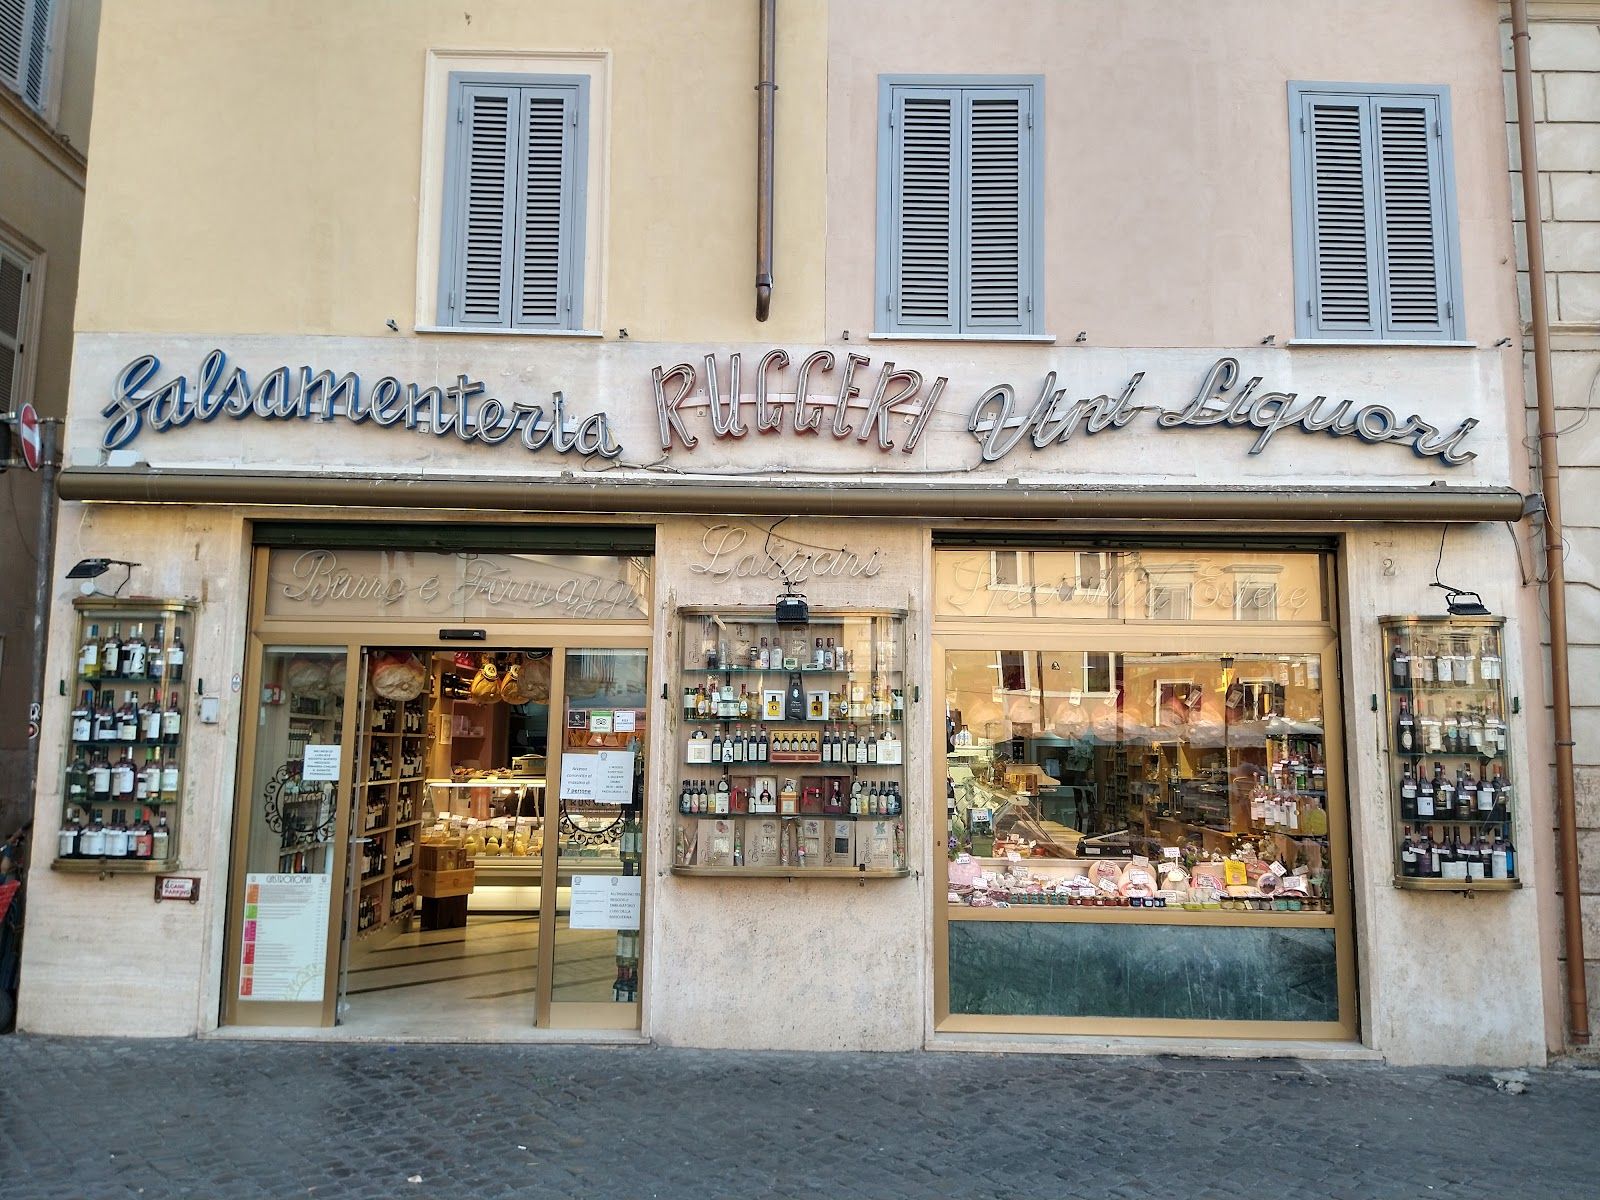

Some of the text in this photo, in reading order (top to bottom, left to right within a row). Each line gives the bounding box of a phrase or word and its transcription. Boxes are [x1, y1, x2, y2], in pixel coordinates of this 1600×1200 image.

[101, 349, 622, 458] Salsamenteria
[651, 348, 948, 454] RUGGERI
[968, 357, 1478, 467] Vini Liquori
[283, 549, 639, 617] Burro e Formaggi
[1383, 558, 1395, 576] 2
